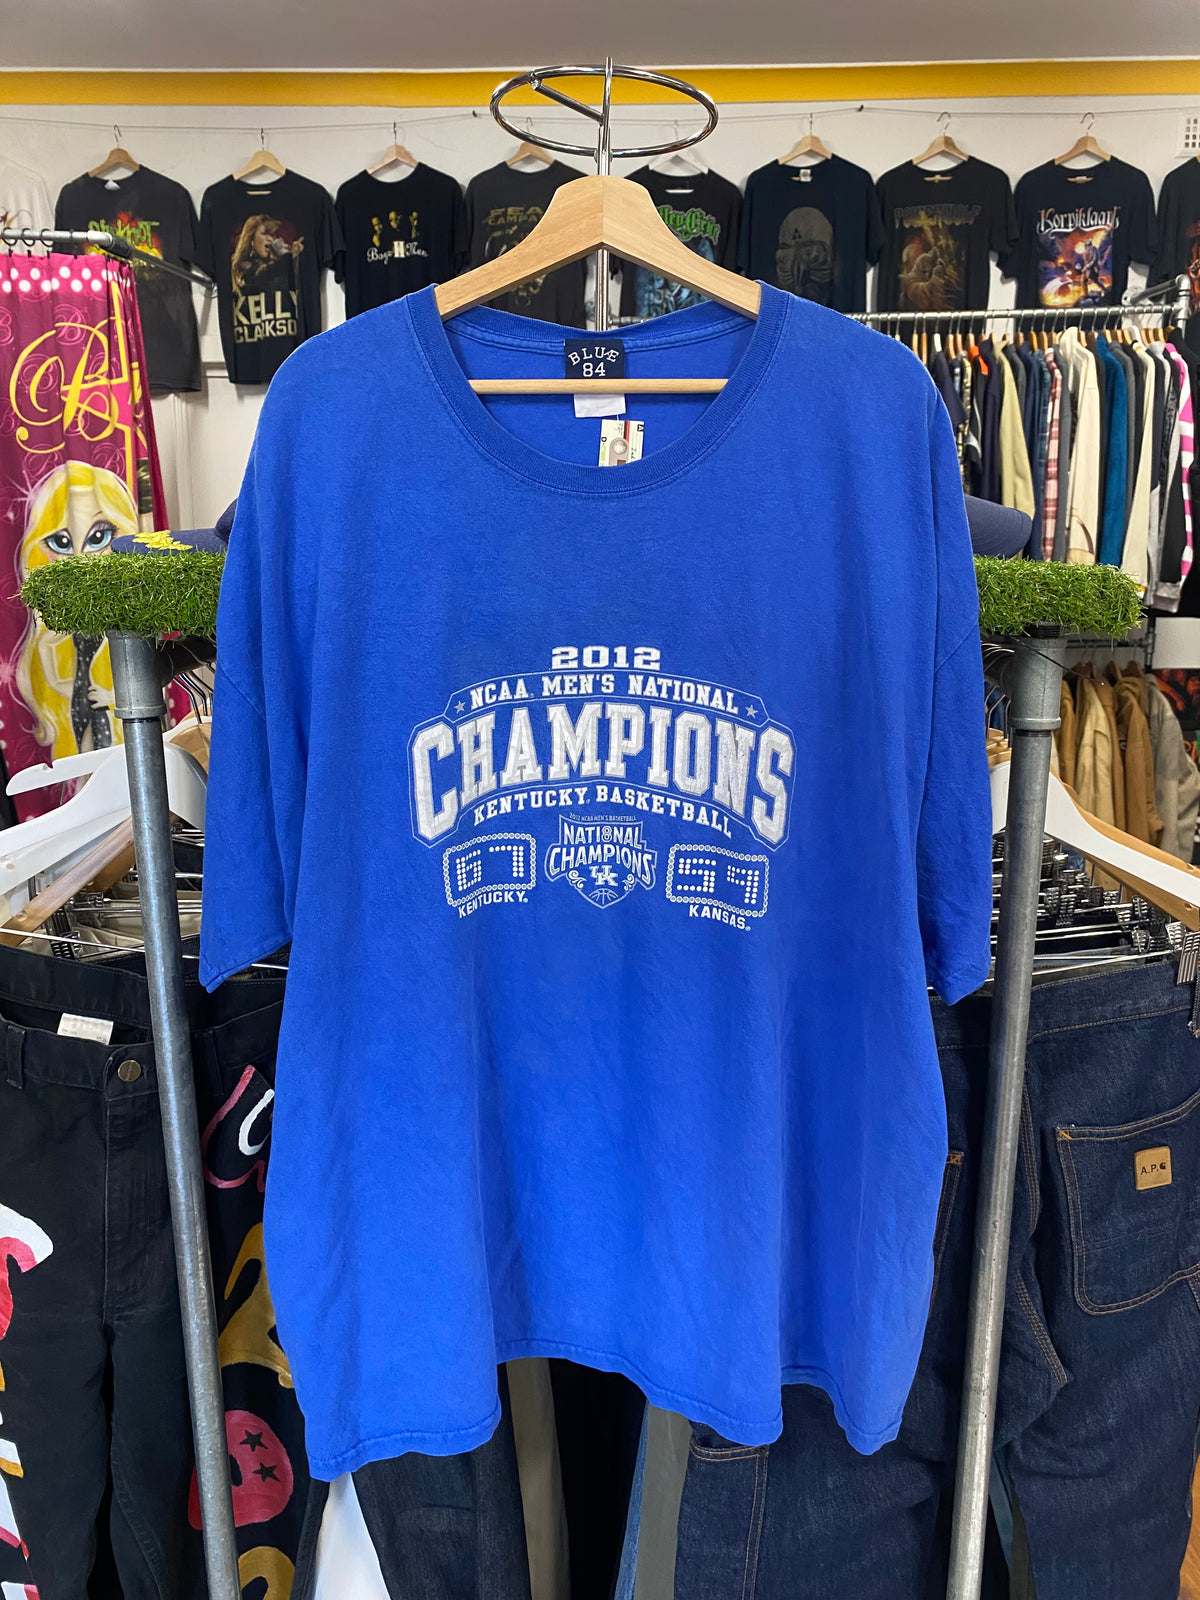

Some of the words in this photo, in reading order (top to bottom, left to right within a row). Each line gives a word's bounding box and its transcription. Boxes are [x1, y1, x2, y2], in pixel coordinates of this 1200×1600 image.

[233, 290, 299, 326] KELLY
[568, 346, 619, 365] BLUE
[583, 362, 606, 377] 84
[551, 645, 661, 671] 2012
[470, 678, 529, 710] NCAA
[541, 674, 615, 697] MEN'S
[628, 674, 738, 715] NATIONAL
[411, 701, 794, 846] CHAMPIONS
[474, 787, 588, 826] KENTUCKY
[596, 785, 732, 839] BASKETBALL
[455, 845, 525, 891] 67
[549, 844, 652, 885] CHAMPIONS
[588, 865, 619, 887] UK
[676, 858, 760, 905] 59
[458, 891, 526, 918] KENTUCKY
[688, 904, 746, 930] KANSAS
